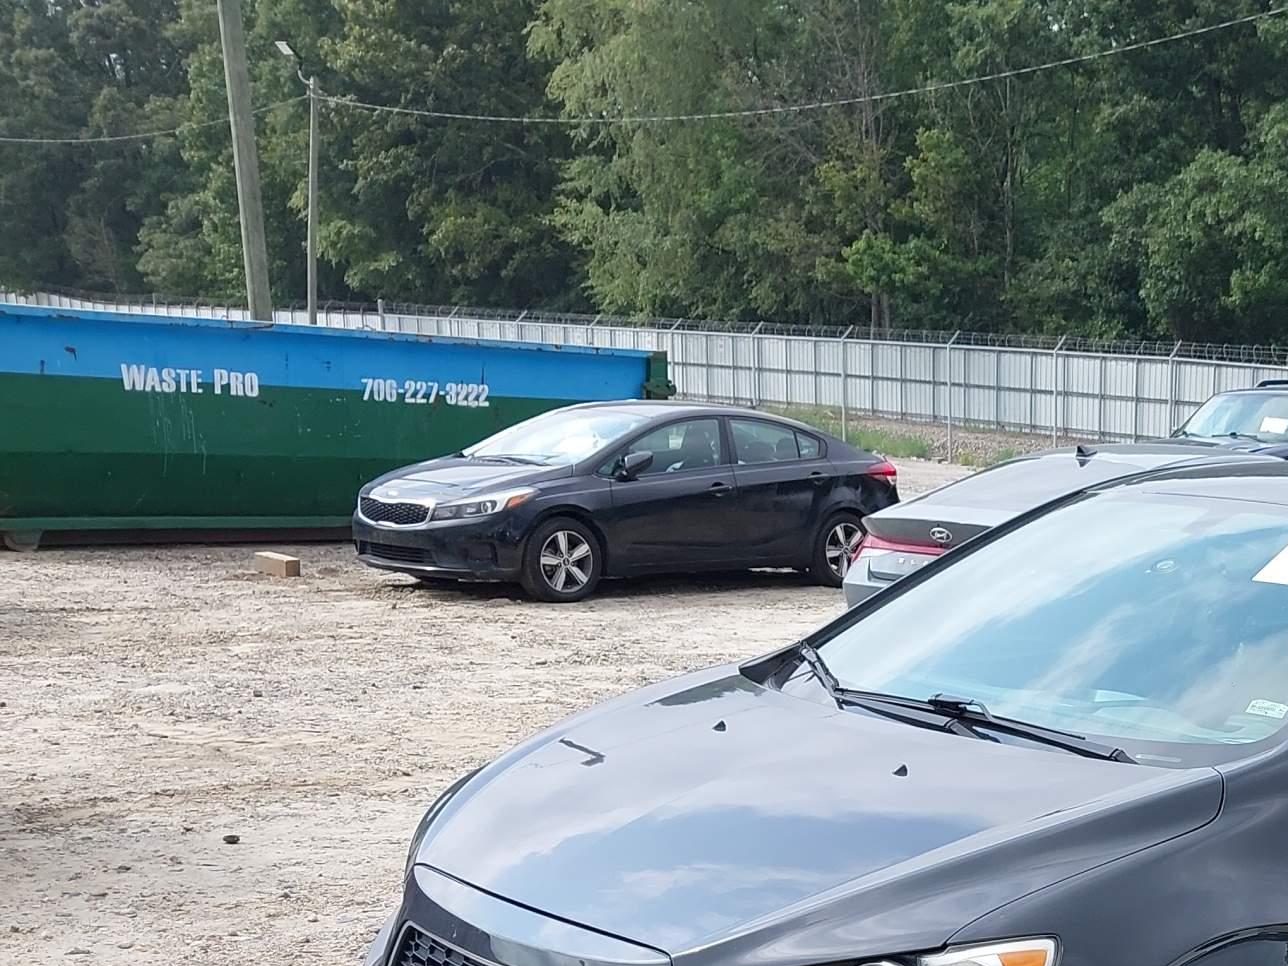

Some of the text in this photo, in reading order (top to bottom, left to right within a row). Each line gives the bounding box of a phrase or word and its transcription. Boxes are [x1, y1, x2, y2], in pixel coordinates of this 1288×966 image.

[120, 363, 260, 398] WASTE PRO
[360, 378, 490, 408] 706-227-3222
